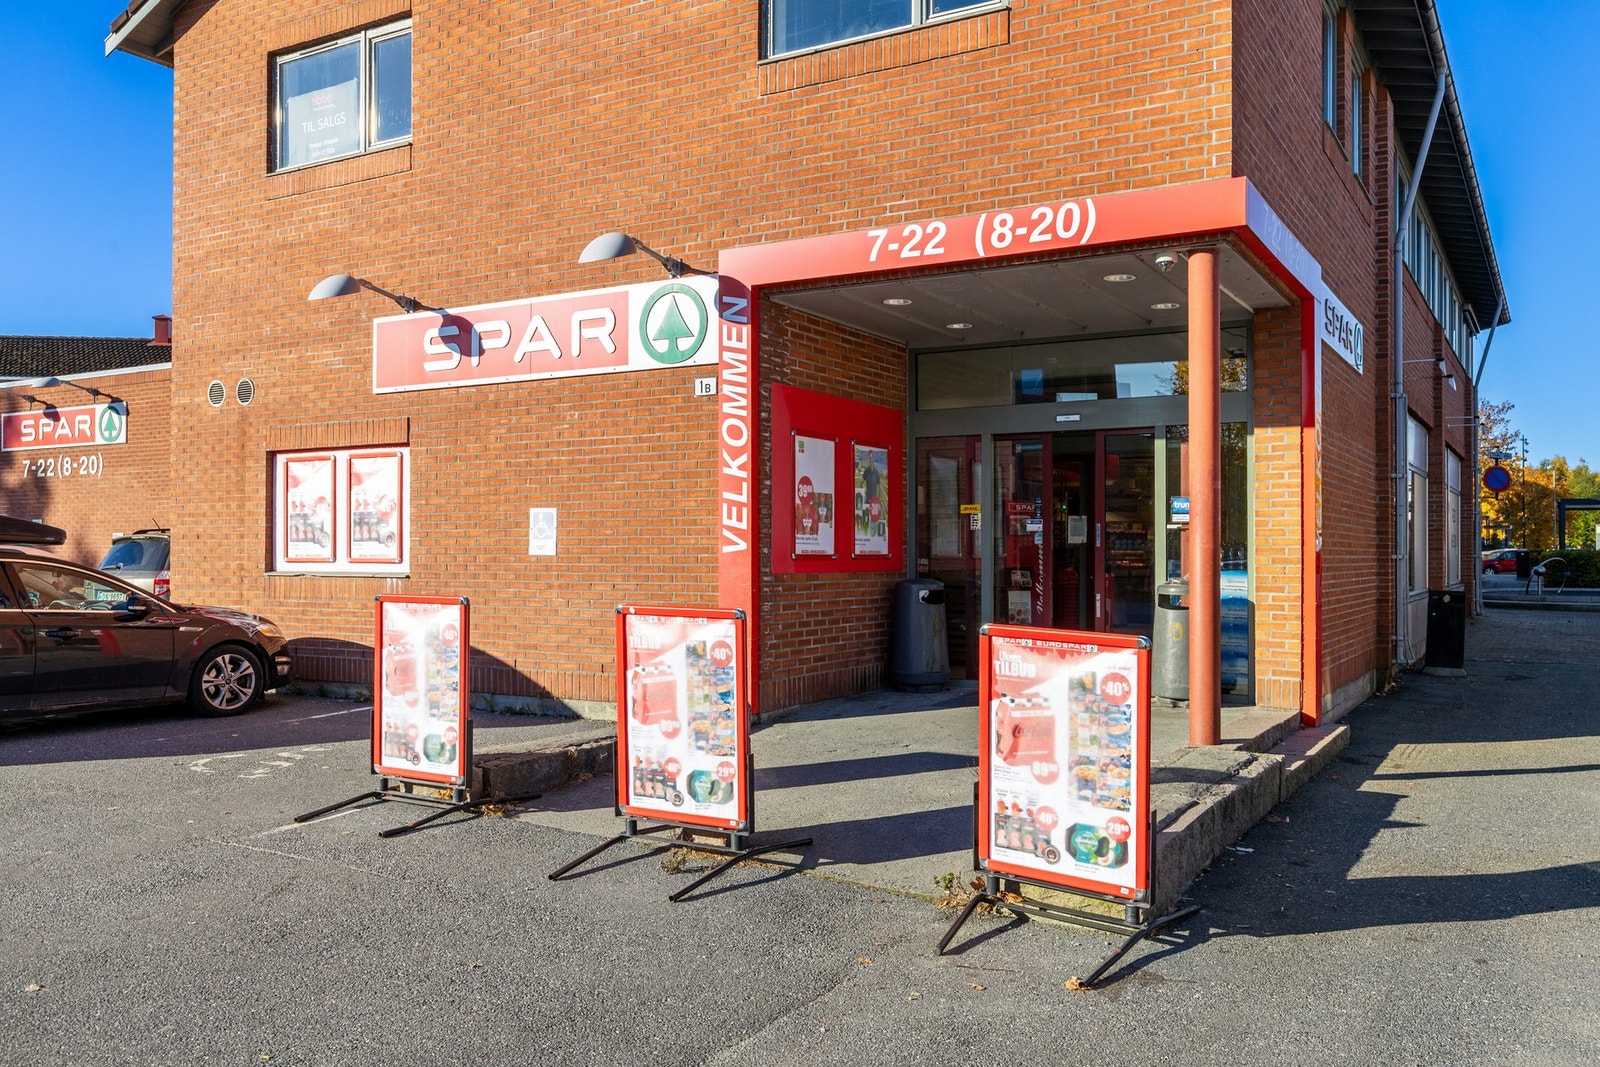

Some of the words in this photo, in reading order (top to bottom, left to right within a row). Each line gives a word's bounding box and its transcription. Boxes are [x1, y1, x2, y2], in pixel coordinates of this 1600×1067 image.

[302, 121, 315, 133] TIL
[317, 112, 346, 130] SALGS
[867, 221, 947, 262] 7-22
[975, 198, 1097, 257] (8-20)
[423, 307, 617, 372] SPAR
[1324, 298, 1354, 355] SPAR
[699, 380, 711, 394] 1B
[20, 415, 91, 442] SPAR
[721, 295, 749, 553] VELKOMMEN
[994, 660, 1036, 678] TILBUD
[1102, 681, 1130, 697] -40%
